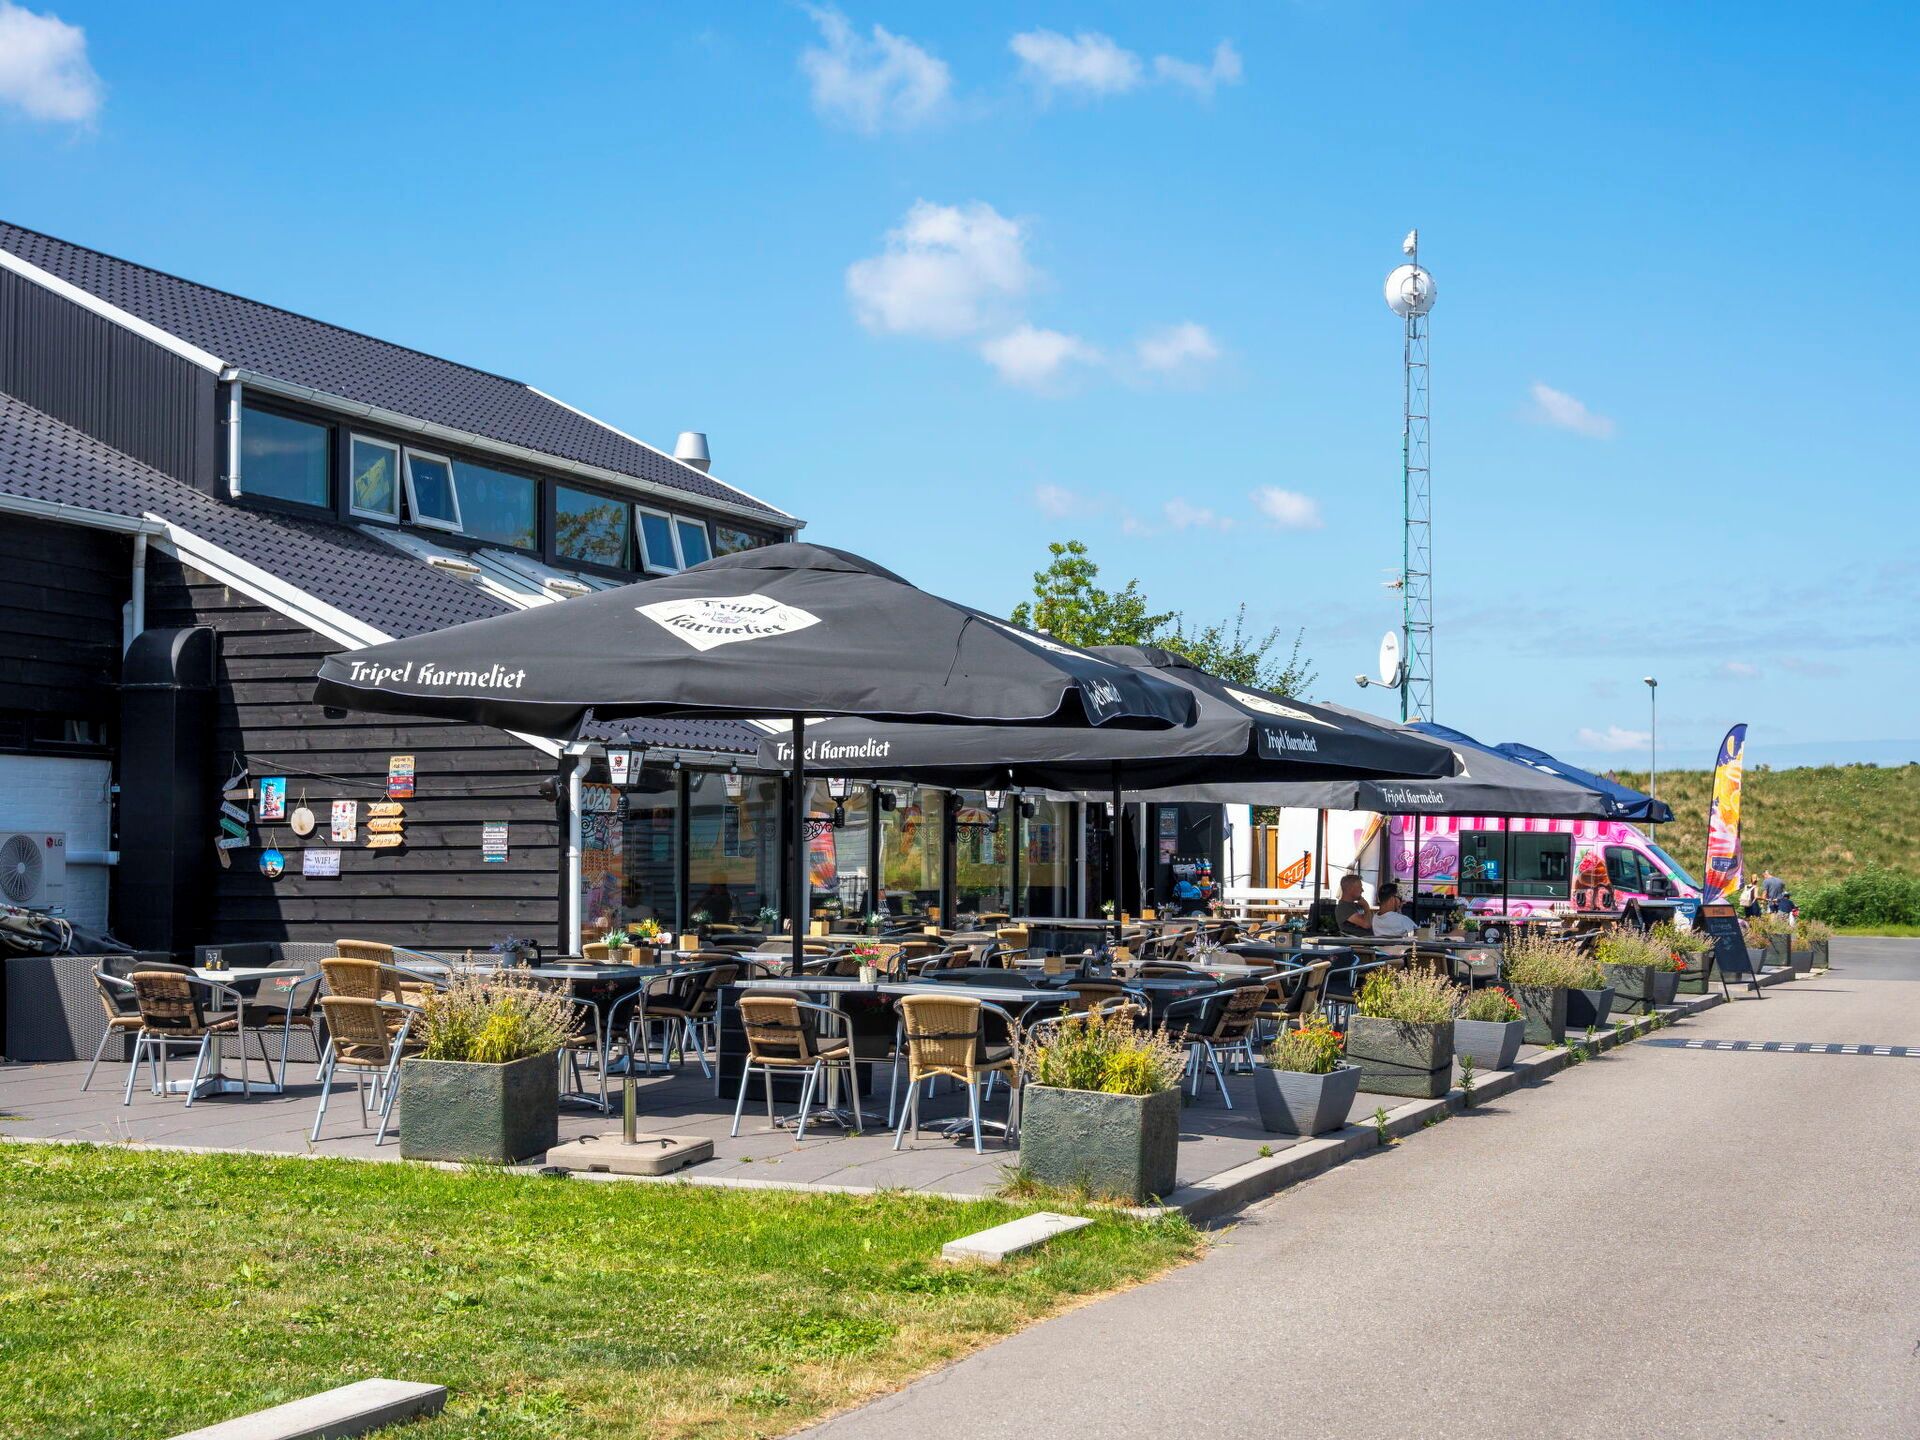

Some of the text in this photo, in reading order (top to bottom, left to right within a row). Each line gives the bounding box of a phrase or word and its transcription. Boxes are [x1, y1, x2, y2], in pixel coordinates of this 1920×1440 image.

[694, 600, 779, 614] Tripel
[664, 614, 785, 634] Karmeliet
[350, 661, 526, 688] Tripel Karmeliet
[777, 737, 890, 761] Triel Karmeliet
[1264, 728, 1286, 755] Tripel
[1382, 788, 1444, 807] Tripel Karmeliet
[54, 839, 63, 847] LG
[314, 857, 332, 865] WIFI
